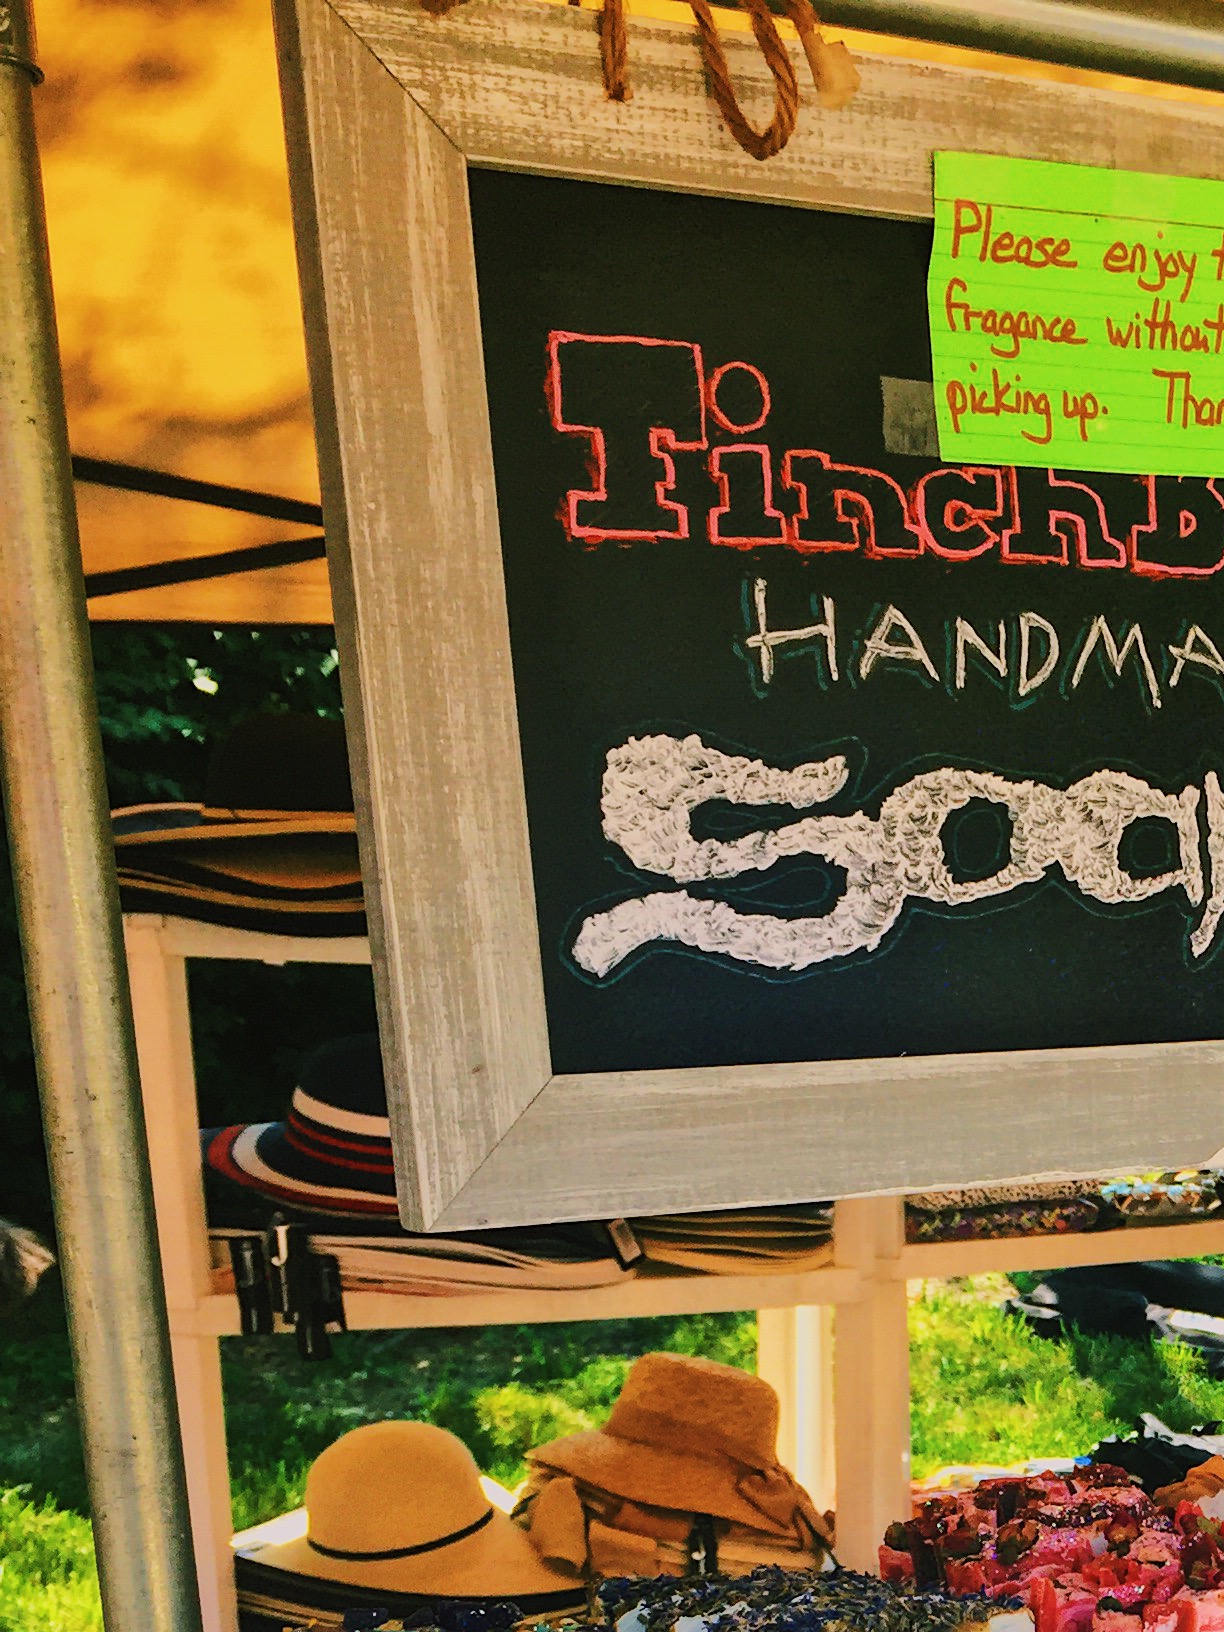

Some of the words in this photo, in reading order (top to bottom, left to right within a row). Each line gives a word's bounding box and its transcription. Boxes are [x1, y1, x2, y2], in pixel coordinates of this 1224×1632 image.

[949, 199, 1078, 269] Please
[1102, 231, 1197, 303] enjoy
[945, 277, 1088, 359] fragance
[946, 362, 1052, 445] picking
[1062, 390, 1109, 443] up.
